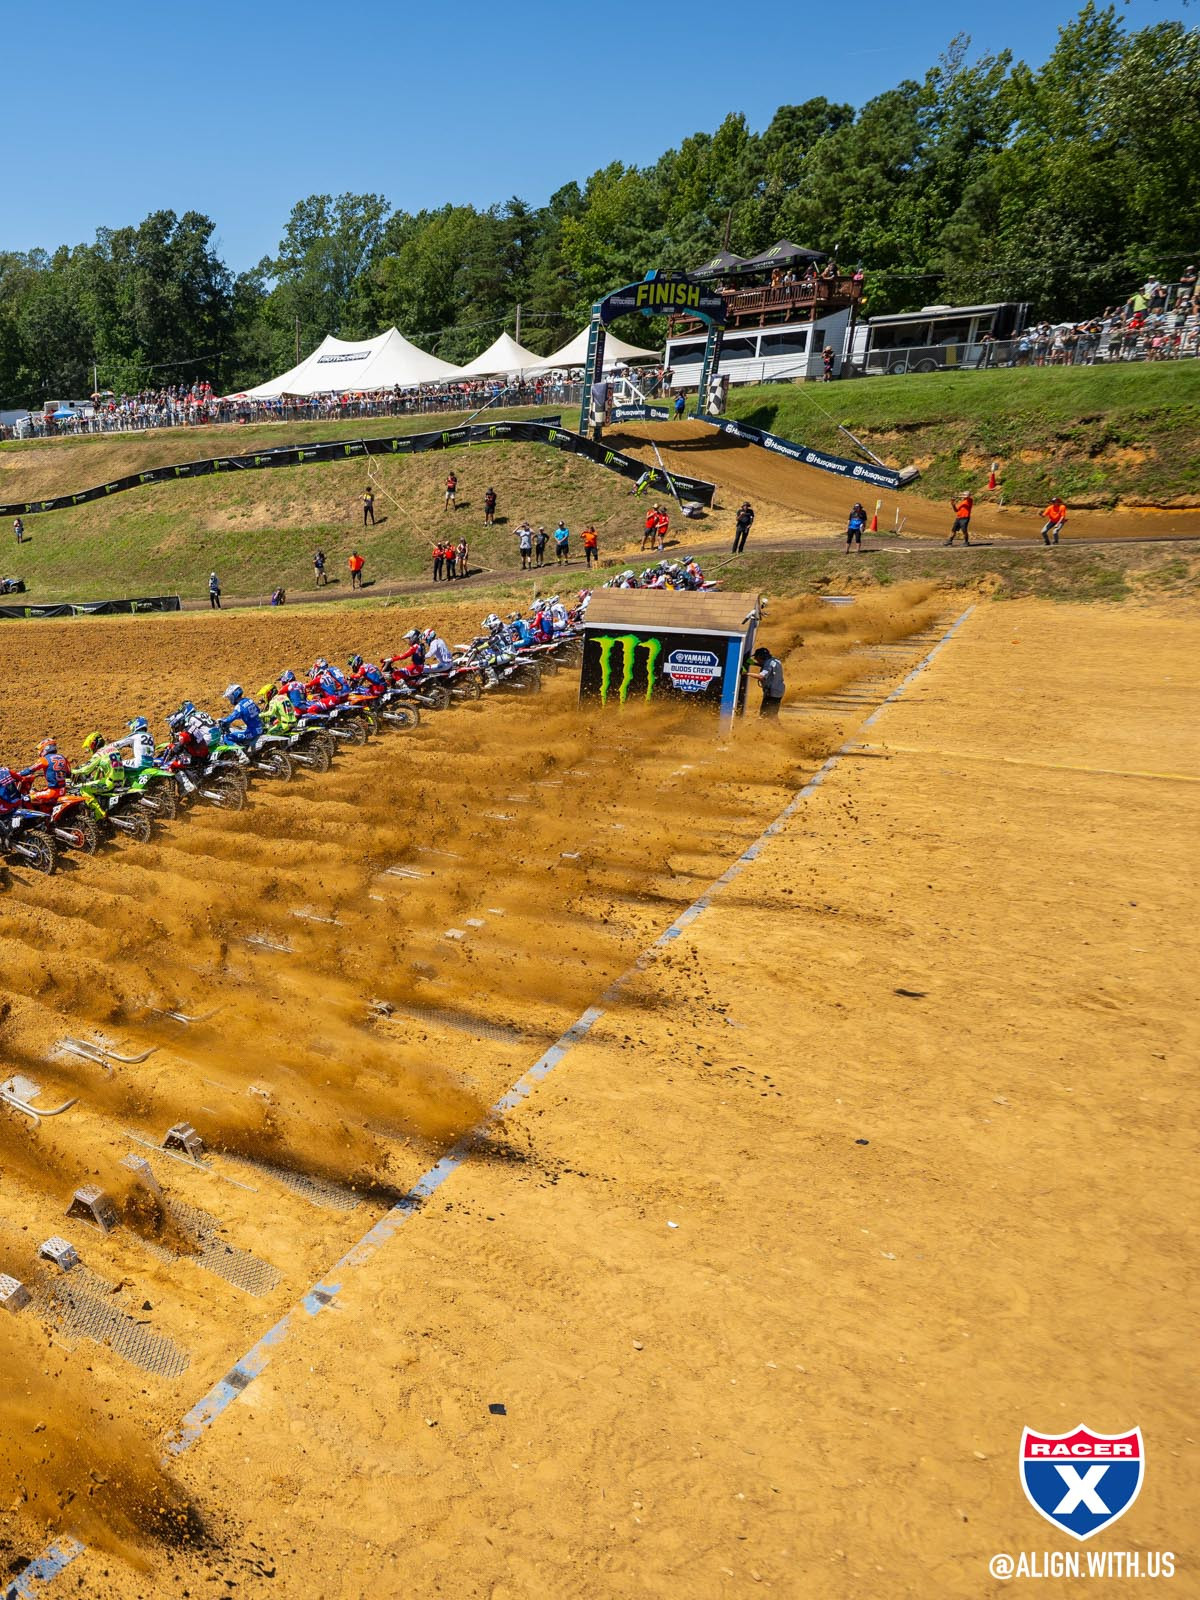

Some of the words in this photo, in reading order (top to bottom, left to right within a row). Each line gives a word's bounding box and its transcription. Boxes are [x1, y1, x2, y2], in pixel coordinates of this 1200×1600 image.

[636, 282, 700, 308] FINISH
[621, 409, 646, 418] Husqvarna
[732, 427, 760, 443] Husqvarna
[770, 441, 800, 458] Husqvarna
[813, 456, 847, 472] Husqvarna
[683, 653, 711, 662] YAMAHA
[674, 679, 708, 687] FINALS
[140, 735, 154, 746] 26
[51, 759, 66, 771] 23
